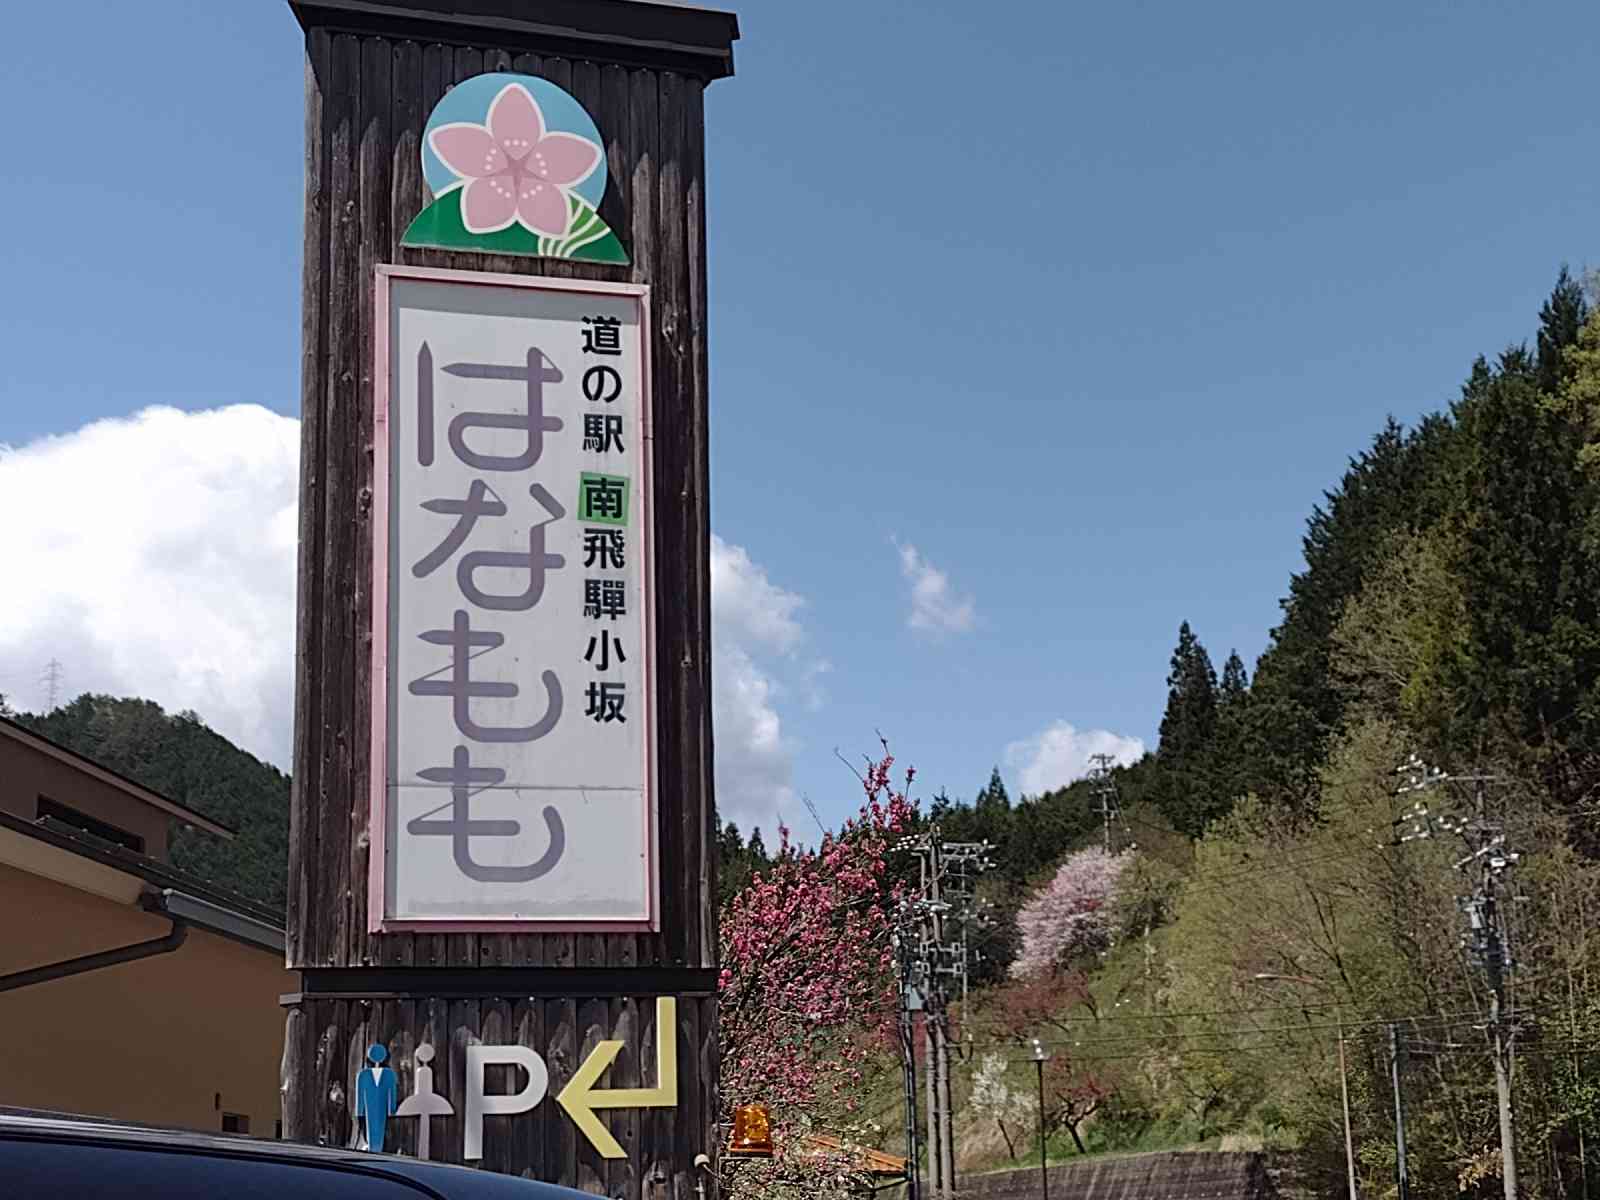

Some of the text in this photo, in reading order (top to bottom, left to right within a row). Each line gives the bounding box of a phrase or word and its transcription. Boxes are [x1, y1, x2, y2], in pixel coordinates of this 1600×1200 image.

[581, 315, 625, 454] 道の駅
[406, 340, 566, 883] はなもも
[464, 1045, 549, 1160] P
